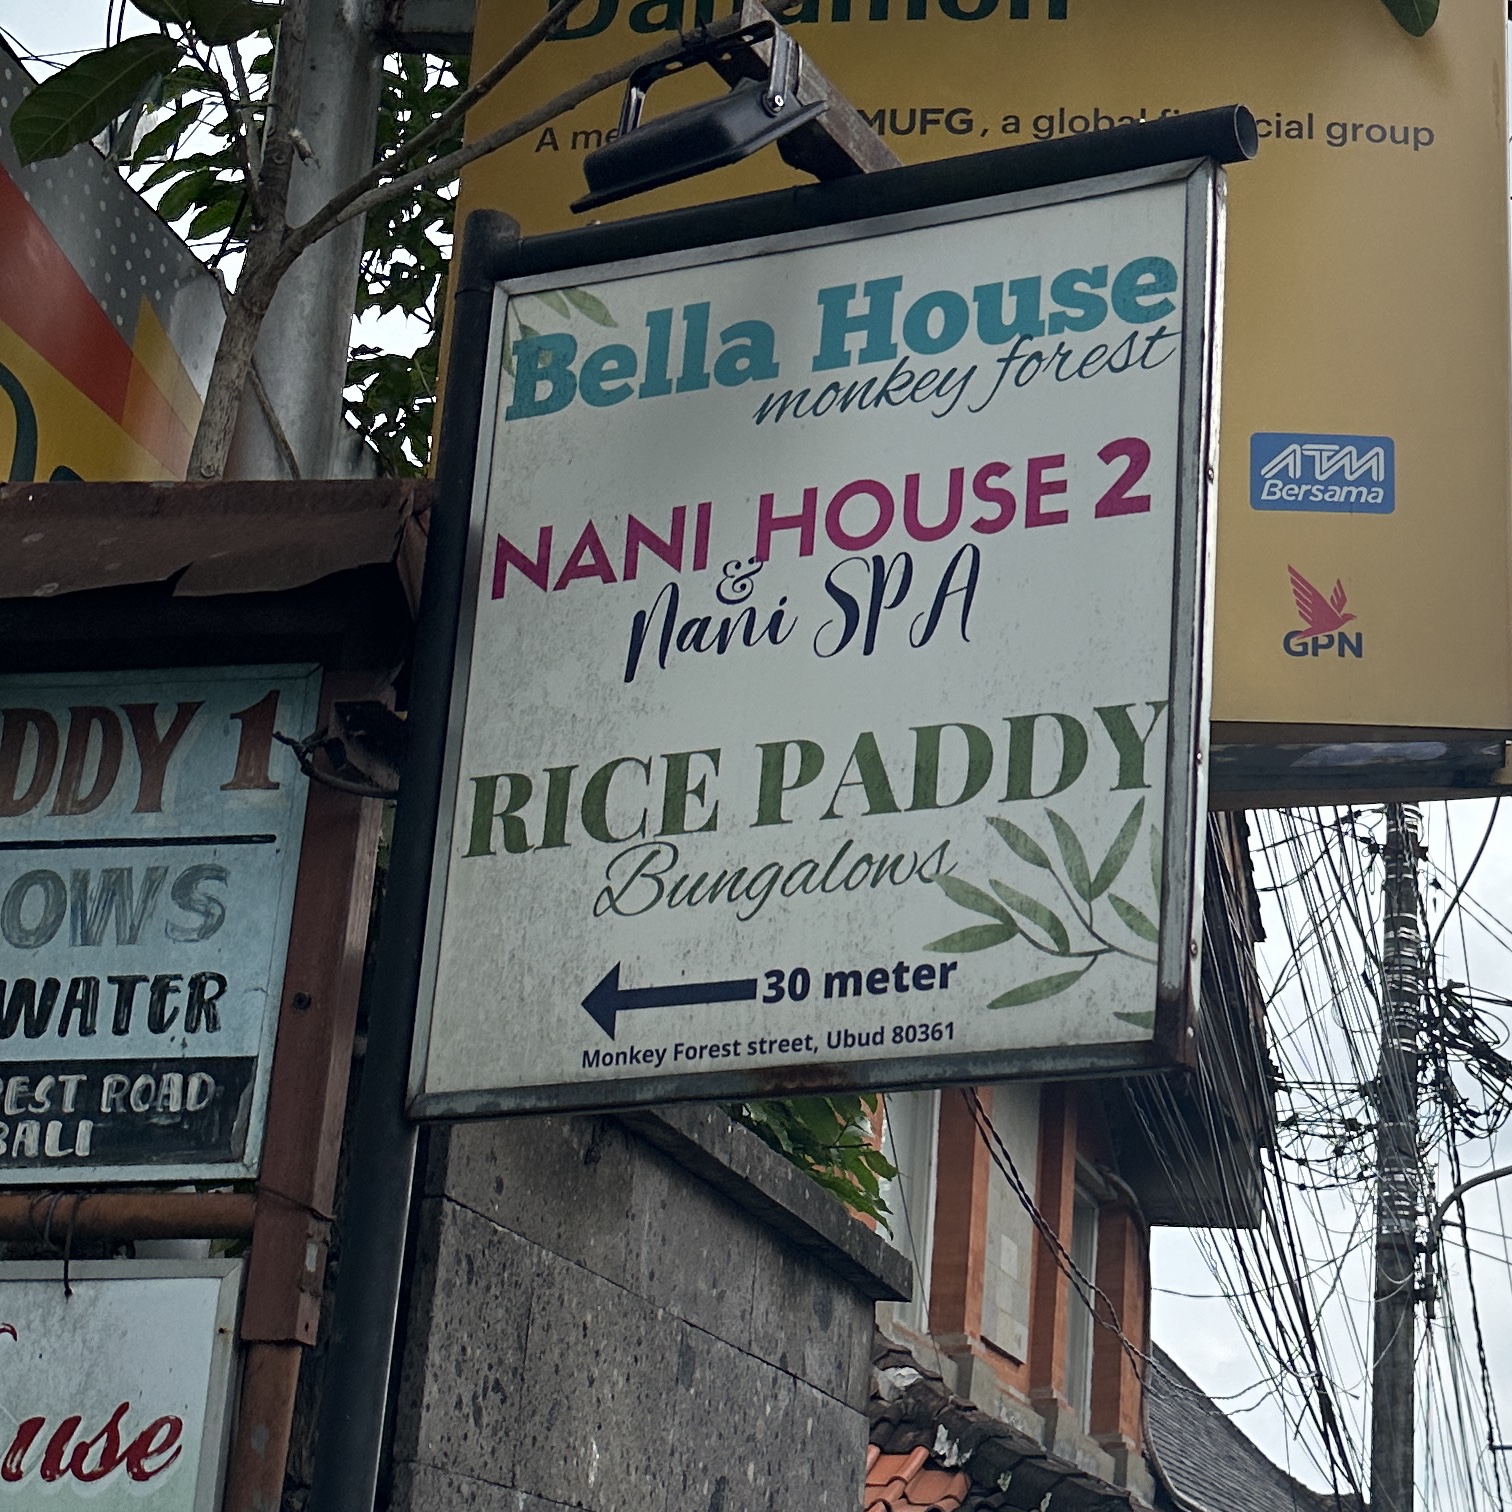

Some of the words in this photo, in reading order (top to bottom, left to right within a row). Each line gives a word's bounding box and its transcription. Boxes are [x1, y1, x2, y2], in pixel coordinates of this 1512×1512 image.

[535, 127, 559, 152] A
[1001, 114, 1020, 134] a
[1326, 122, 1435, 152] group
[505, 302, 779, 421] Bella
[811, 255, 1178, 371] House
[752, 355, 979, 425] monkey
[986, 323, 1181, 411] forest
[1261, 443, 1384, 482] ATM
[1261, 478, 1384, 504] Bersama
[492, 502, 711, 599] NANI
[754, 453, 1069, 562] HOUSE
[1094, 437, 1150, 519] 2
[624, 582, 798, 683] Nani
[813, 544, 981, 659] SPA
[717, 558, 762, 605] &
[1283, 630, 1363, 658] GPN
[0, 701, 206, 817] DDY
[220, 689, 280, 790] 1
[462, 747, 721, 858] RICE
[750, 700, 1168, 829] PADDY
[1, 864, 230, 949] OWS
[593, 838, 958, 921] Bungalows
[0, 971, 228, 1039] WATER
[762, 967, 811, 1003] 30
[824, 960, 958, 999] meter
[582, 1044, 667, 1069] Monkey
[673, 1037, 741, 1061] Forest
[747, 1036, 819, 1055] street,
[826, 1026, 885, 1049] Ubud
[891, 1021, 955, 1044] 80361
[0, 1074, 87, 1116] EST
[100, 1071, 216, 1114] ROAD
[1, 1401, 183, 1482] use
